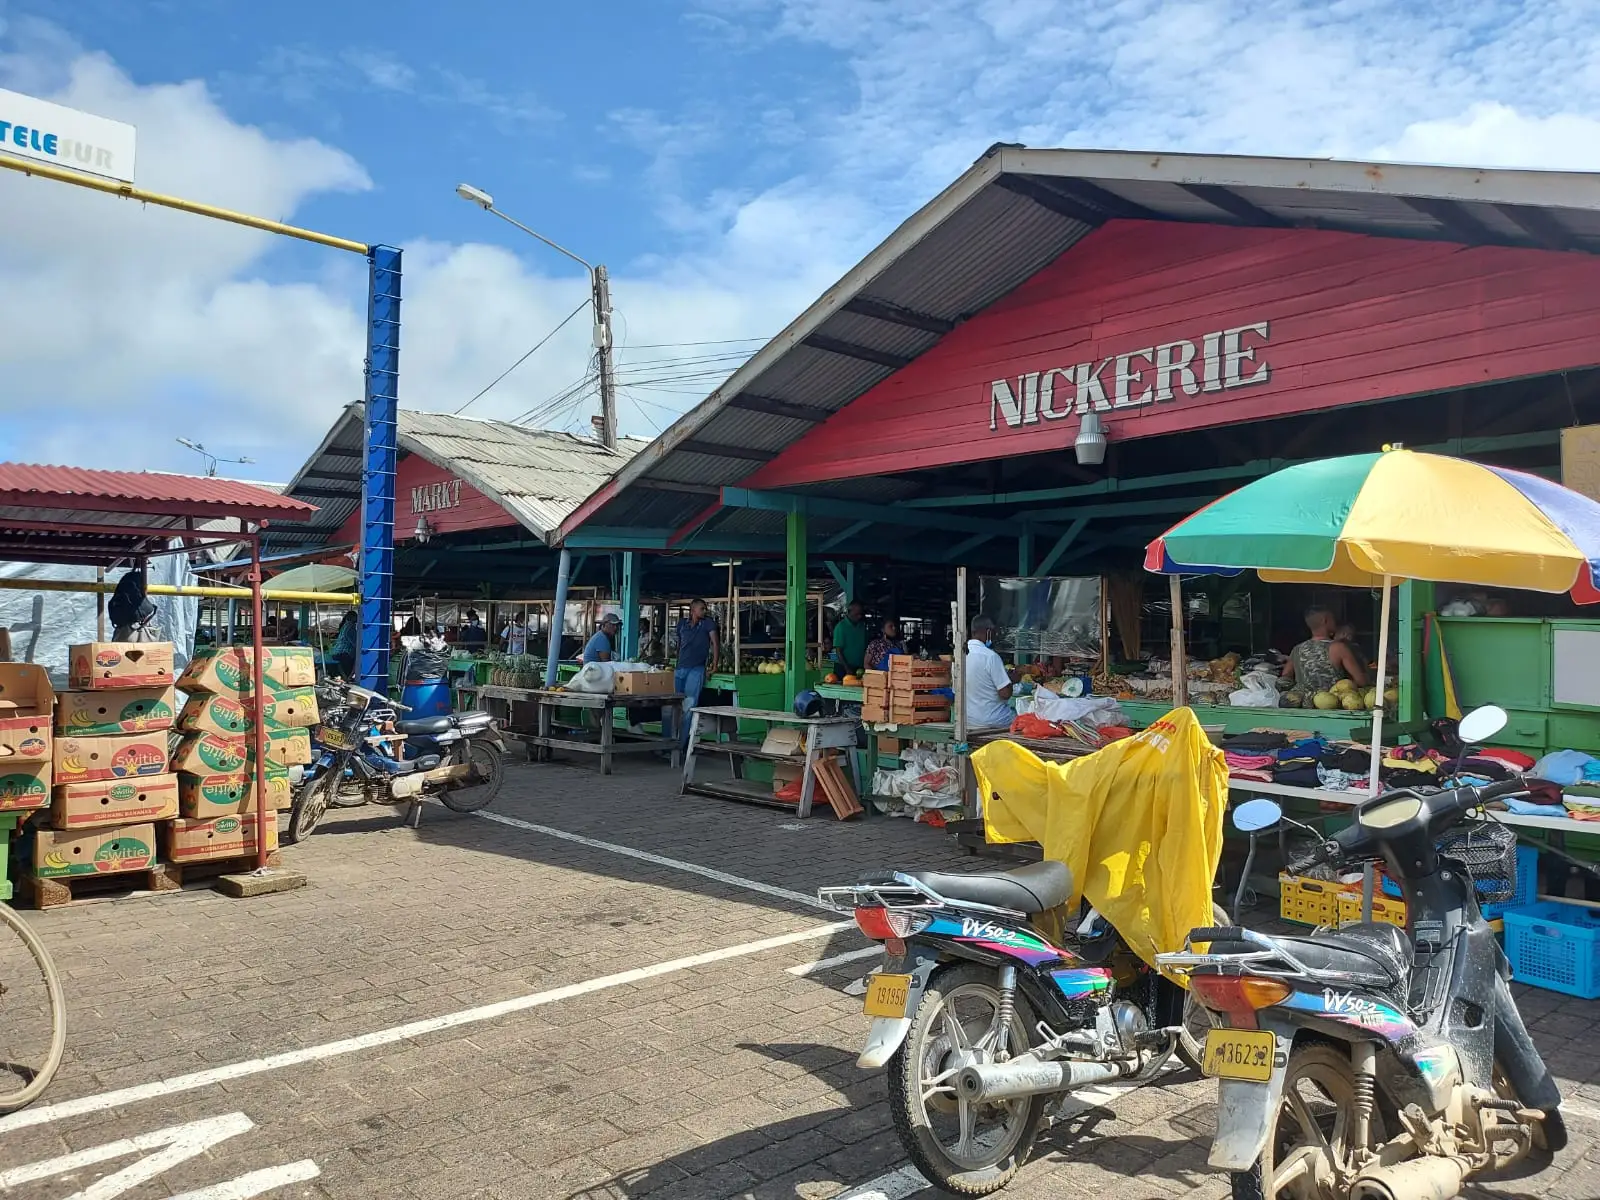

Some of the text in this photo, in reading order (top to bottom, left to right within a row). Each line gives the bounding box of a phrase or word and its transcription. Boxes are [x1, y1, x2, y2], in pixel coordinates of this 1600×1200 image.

[989, 321, 1270, 430] NICKERIE
[411, 479, 462, 514] MARKT
[125, 706, 169, 721] Switie
[116, 752, 162, 767] Switie
[203, 746, 239, 767] Switie
[0, 783, 42, 796] witie
[100, 846, 146, 861] Switie
[877, 986, 907, 1006] 191950
